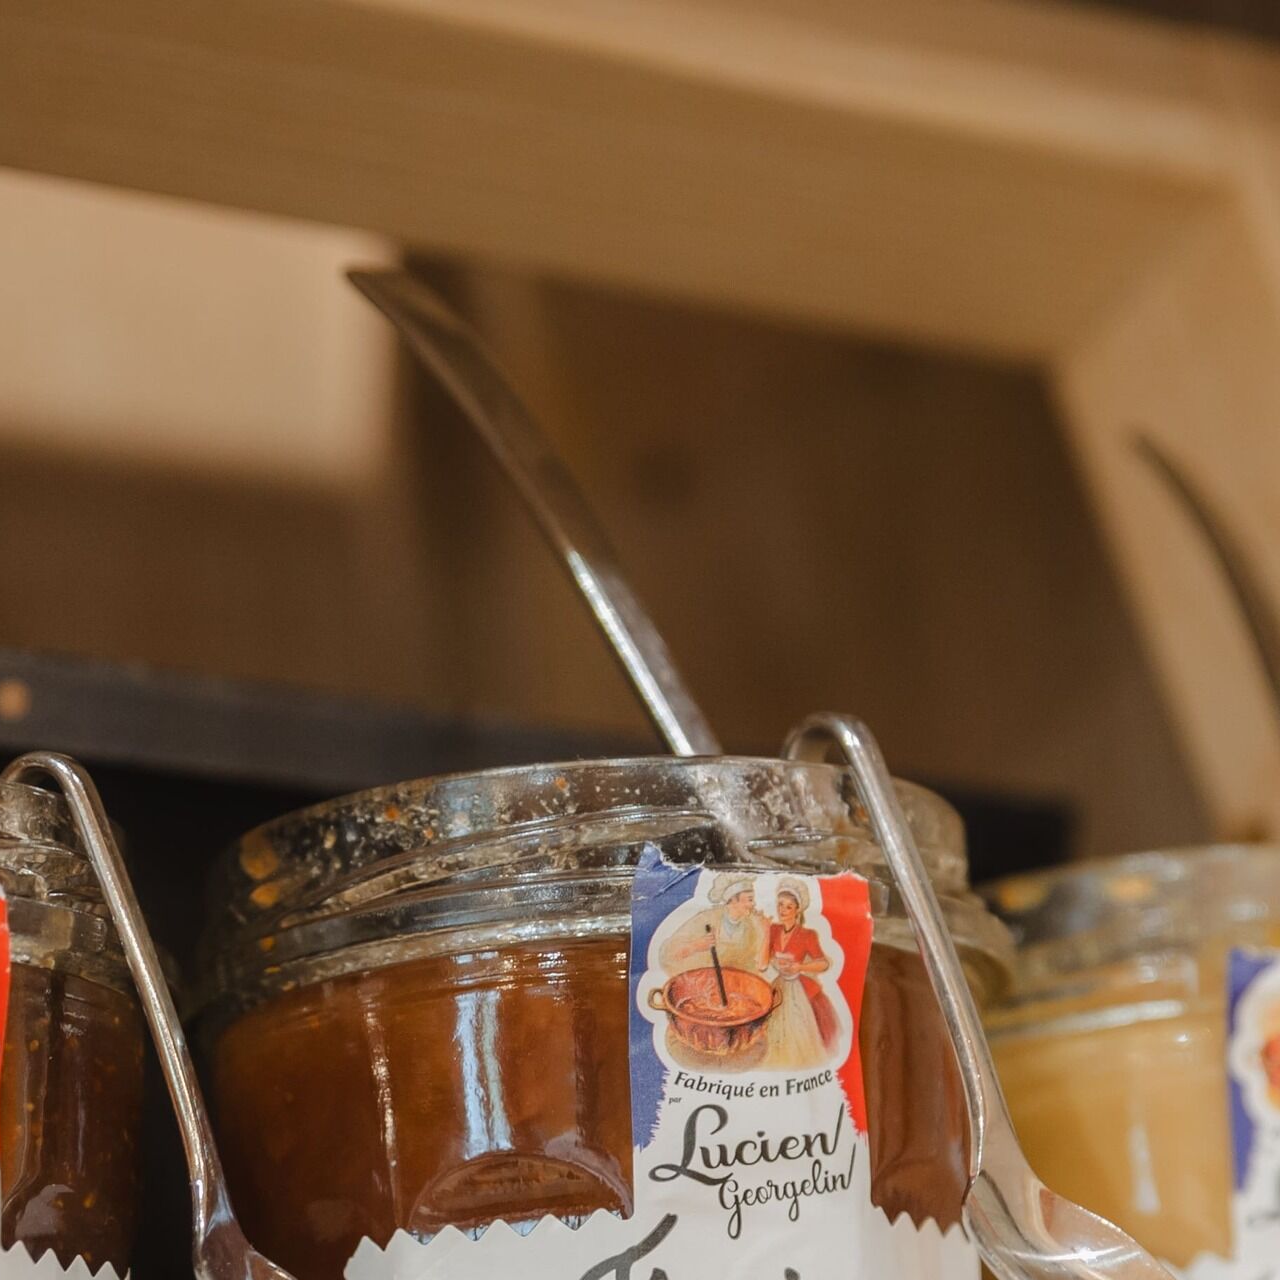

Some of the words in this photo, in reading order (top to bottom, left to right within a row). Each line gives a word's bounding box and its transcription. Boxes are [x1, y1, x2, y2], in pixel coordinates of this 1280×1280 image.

[668, 1095, 682, 1105] par
[674, 1070, 754, 1101] Fabriqué
[759, 1084, 780, 1098] en
[785, 1068, 833, 1096] France
[648, 1102, 845, 1186] Lucien
[719, 1142, 857, 1240] Georgelin
